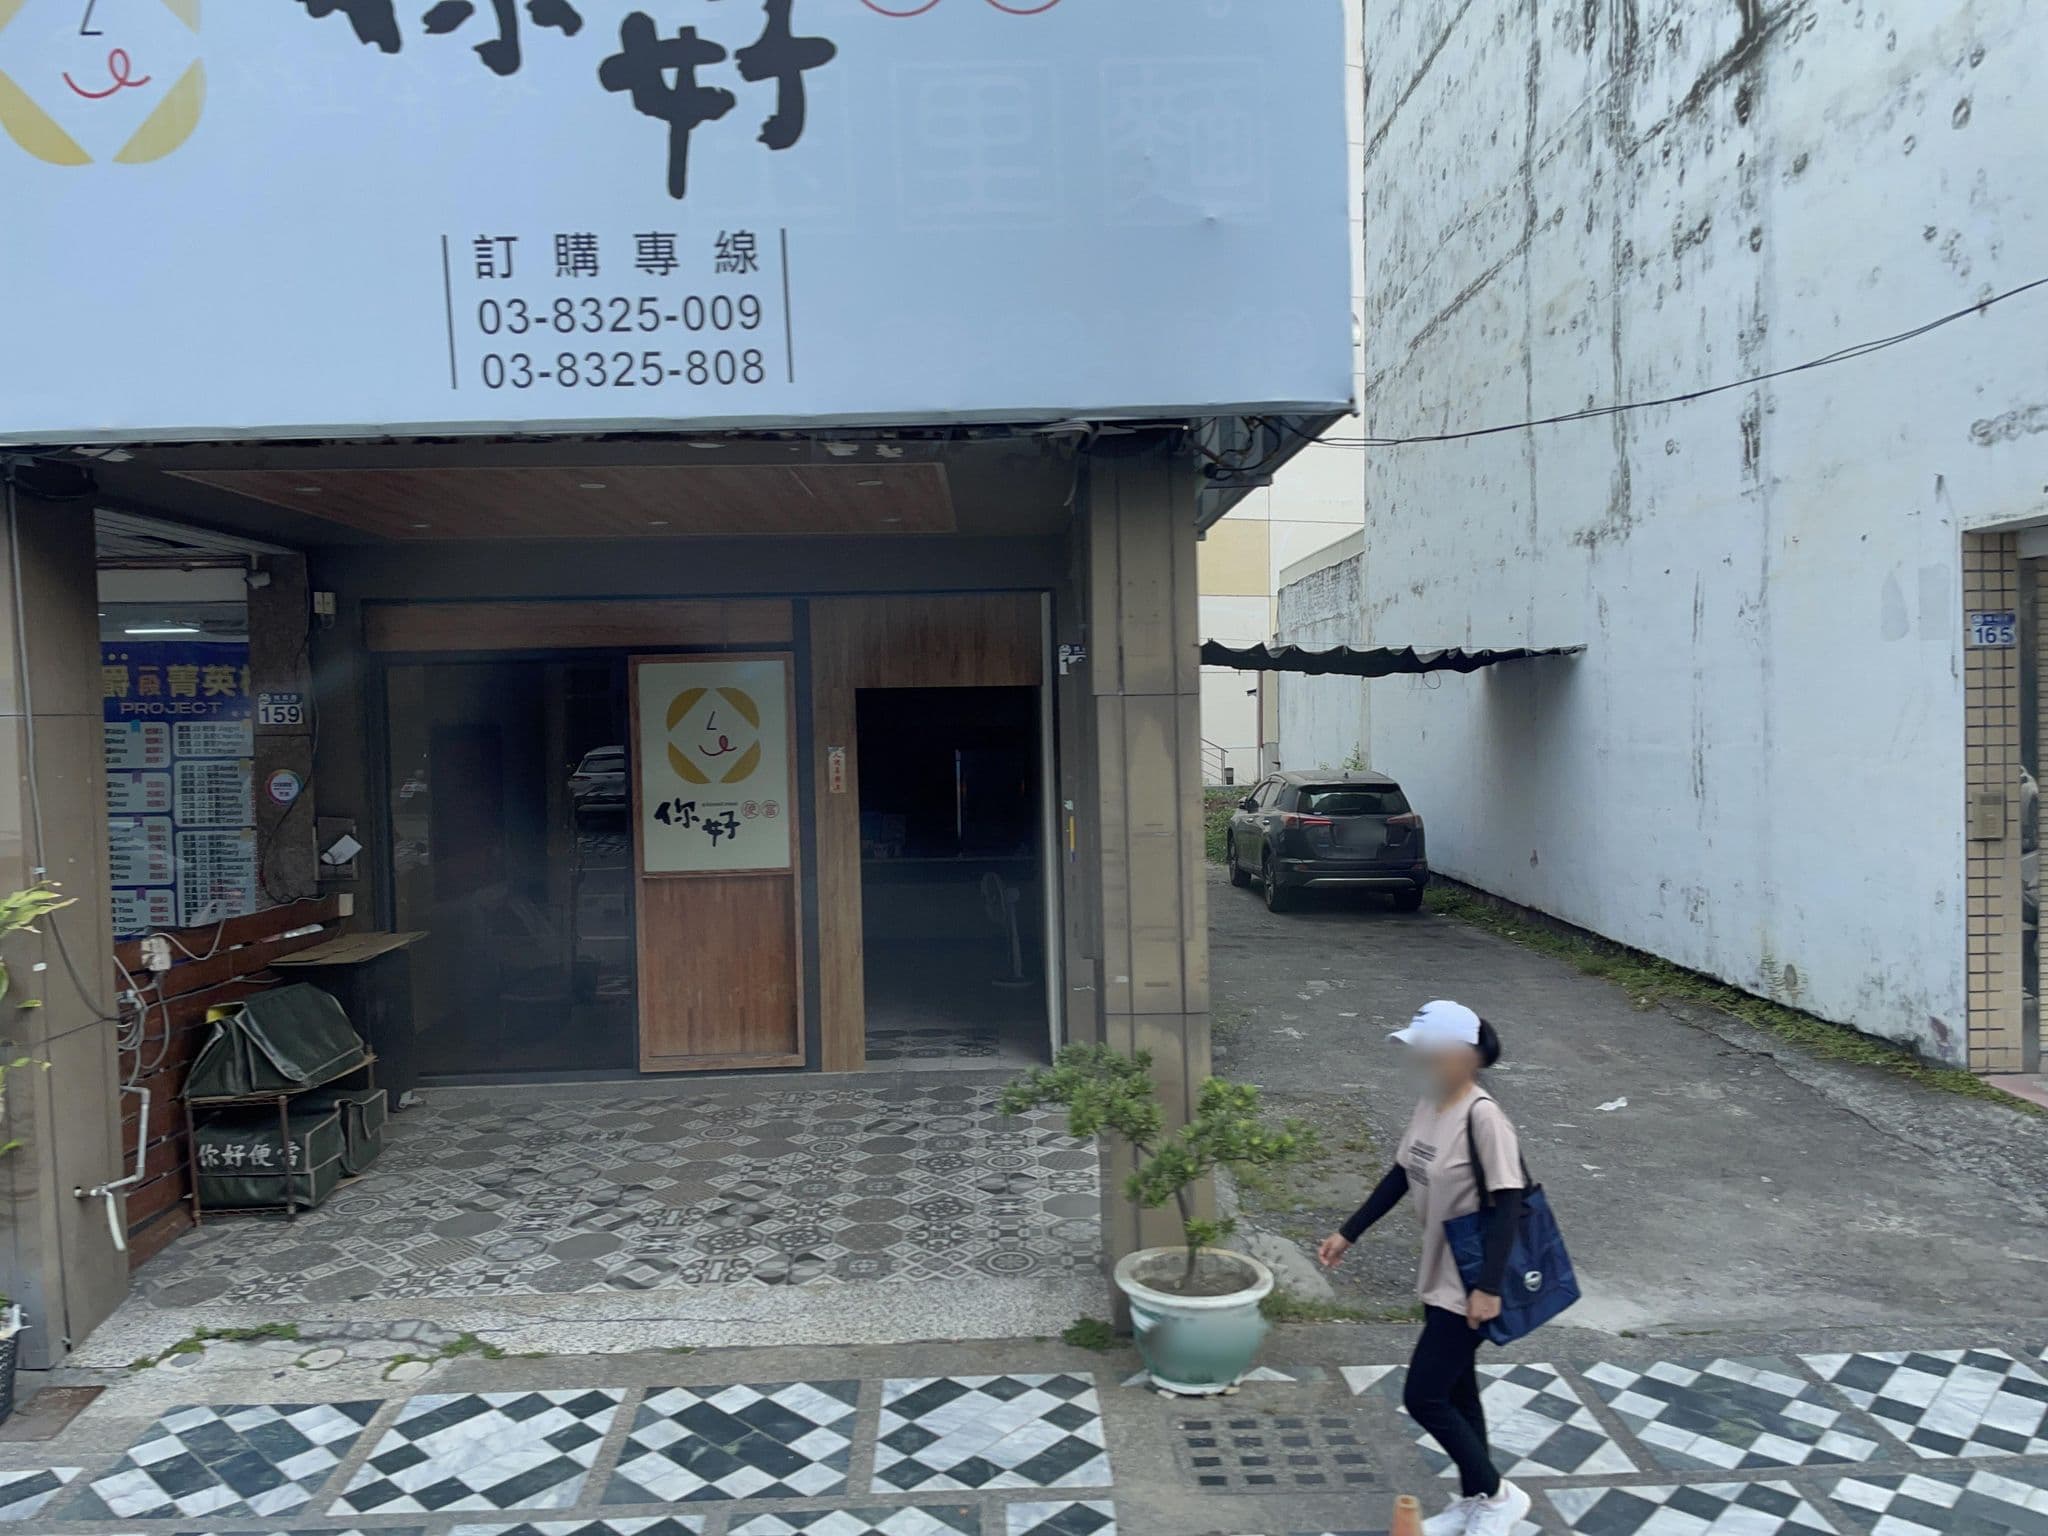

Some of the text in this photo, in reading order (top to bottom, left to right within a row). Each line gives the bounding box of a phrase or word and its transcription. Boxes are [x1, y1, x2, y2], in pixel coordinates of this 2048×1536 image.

[473, 231, 760, 279] 訂購專線
[479, 294, 762, 334] 03-8325-009
[482, 348, 765, 389] 03-8325-808
[1975, 626, 2013, 644] 165
[120, 702, 223, 715] PROJECT
[261, 706, 300, 723] 159
[654, 798, 740, 847] 你好
